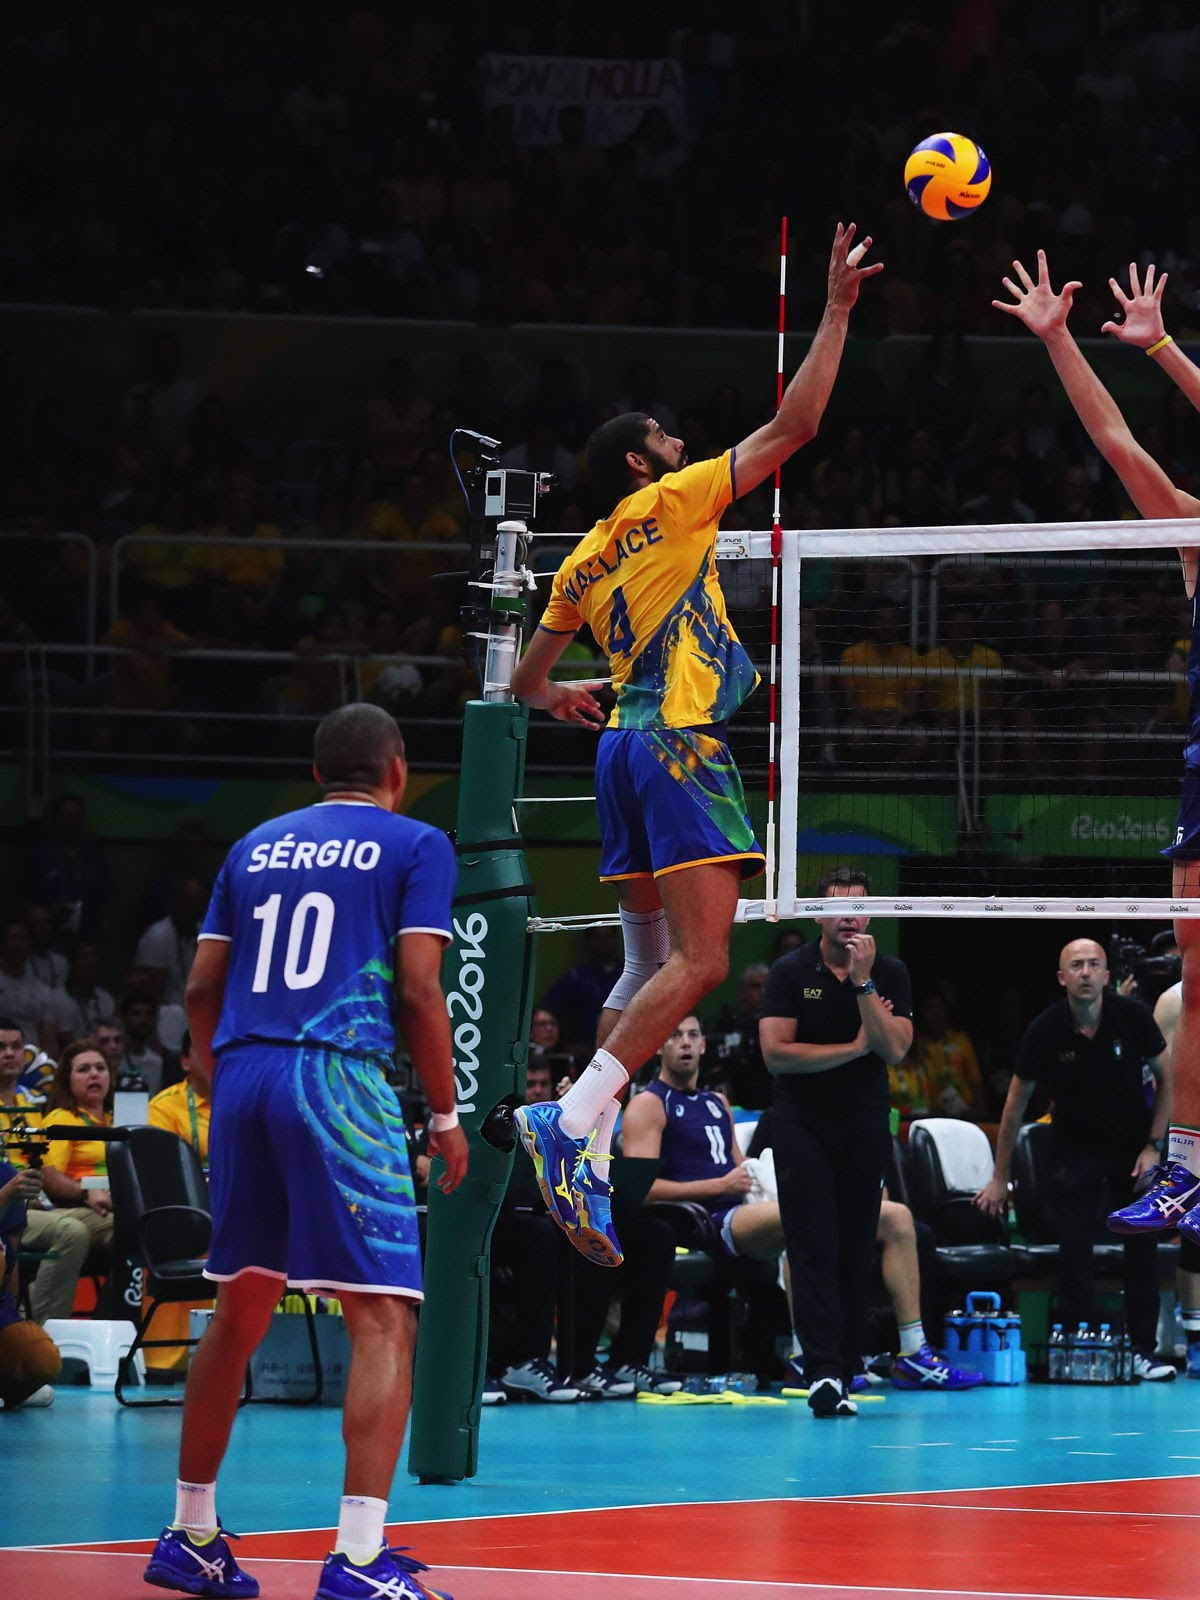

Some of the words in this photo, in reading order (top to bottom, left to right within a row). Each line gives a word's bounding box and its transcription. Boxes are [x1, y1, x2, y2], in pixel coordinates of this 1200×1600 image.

[608, 585, 636, 659] 4
[247, 833, 381, 873] SÉRGIO
[252, 891, 335, 993] 10
[803, 988, 823, 996] EA7
[704, 1125, 727, 1165] 11
